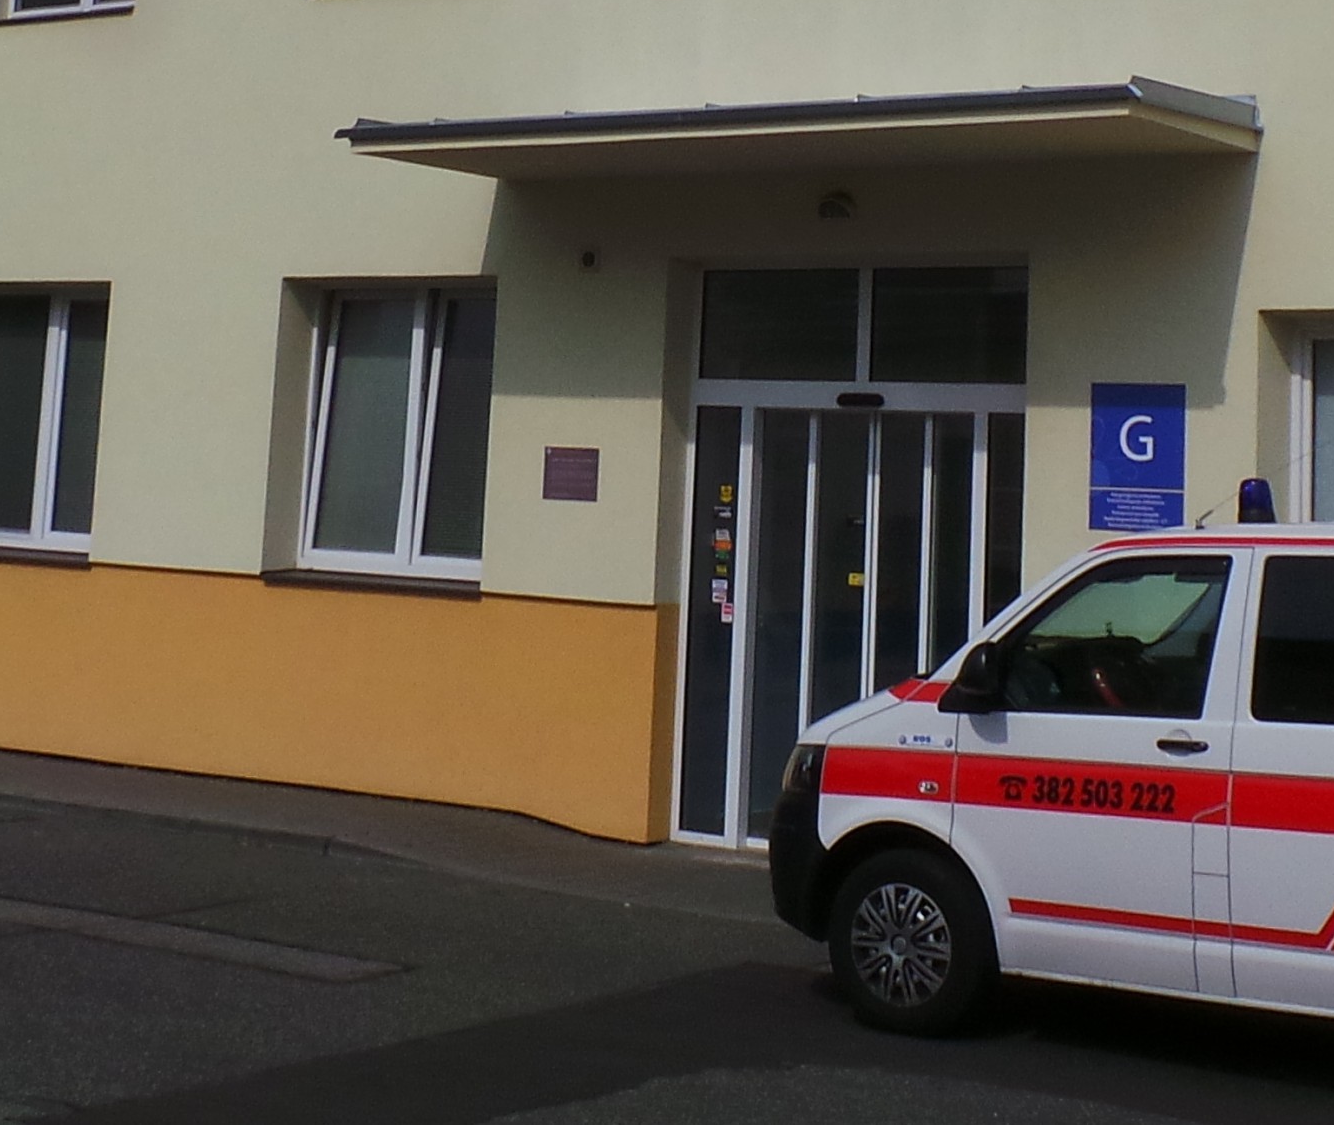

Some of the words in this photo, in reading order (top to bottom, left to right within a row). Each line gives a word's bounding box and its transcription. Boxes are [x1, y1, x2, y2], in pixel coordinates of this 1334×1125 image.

[1119, 415, 1154, 462] G
[1031, 775, 1074, 806] 382
[1079, 778, 1124, 810] 503
[1130, 782, 1176, 814] 222
